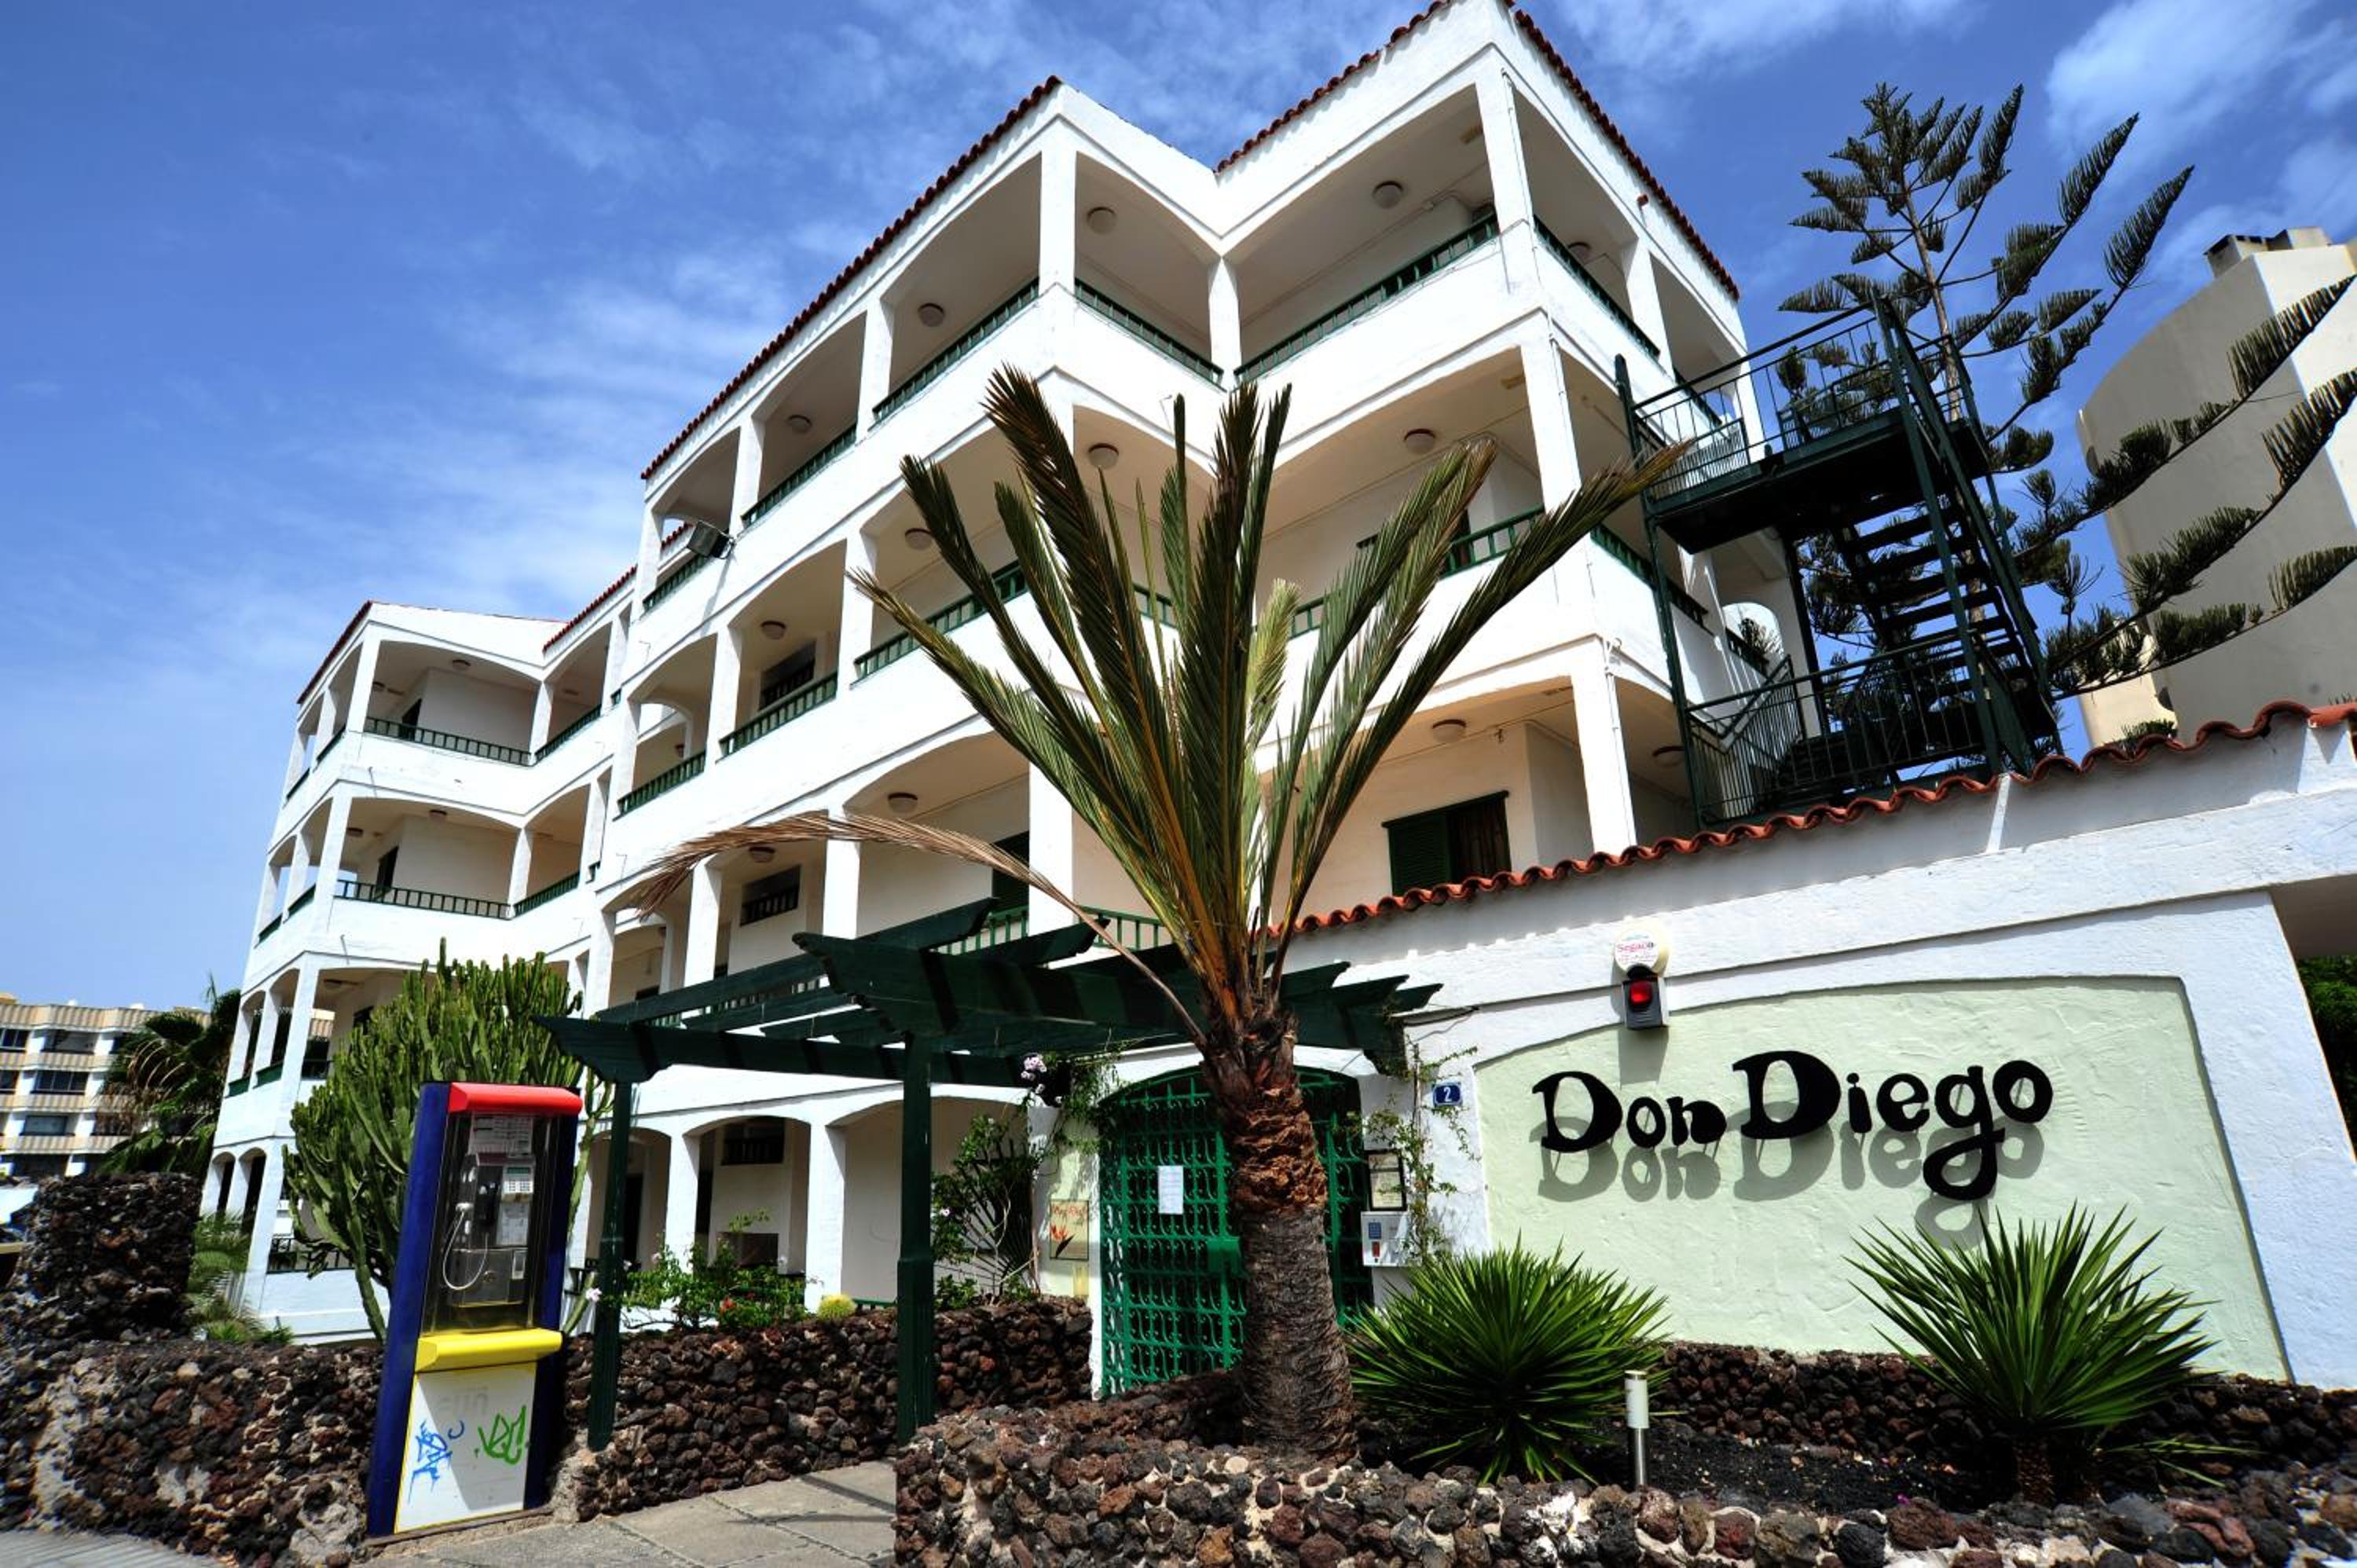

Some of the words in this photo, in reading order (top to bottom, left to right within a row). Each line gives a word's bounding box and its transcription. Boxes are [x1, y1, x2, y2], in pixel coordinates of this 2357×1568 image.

[1443, 1086, 1452, 1102] 2
[1533, 1071, 1728, 1153] Don
[1732, 1050, 2053, 1202] Diego
